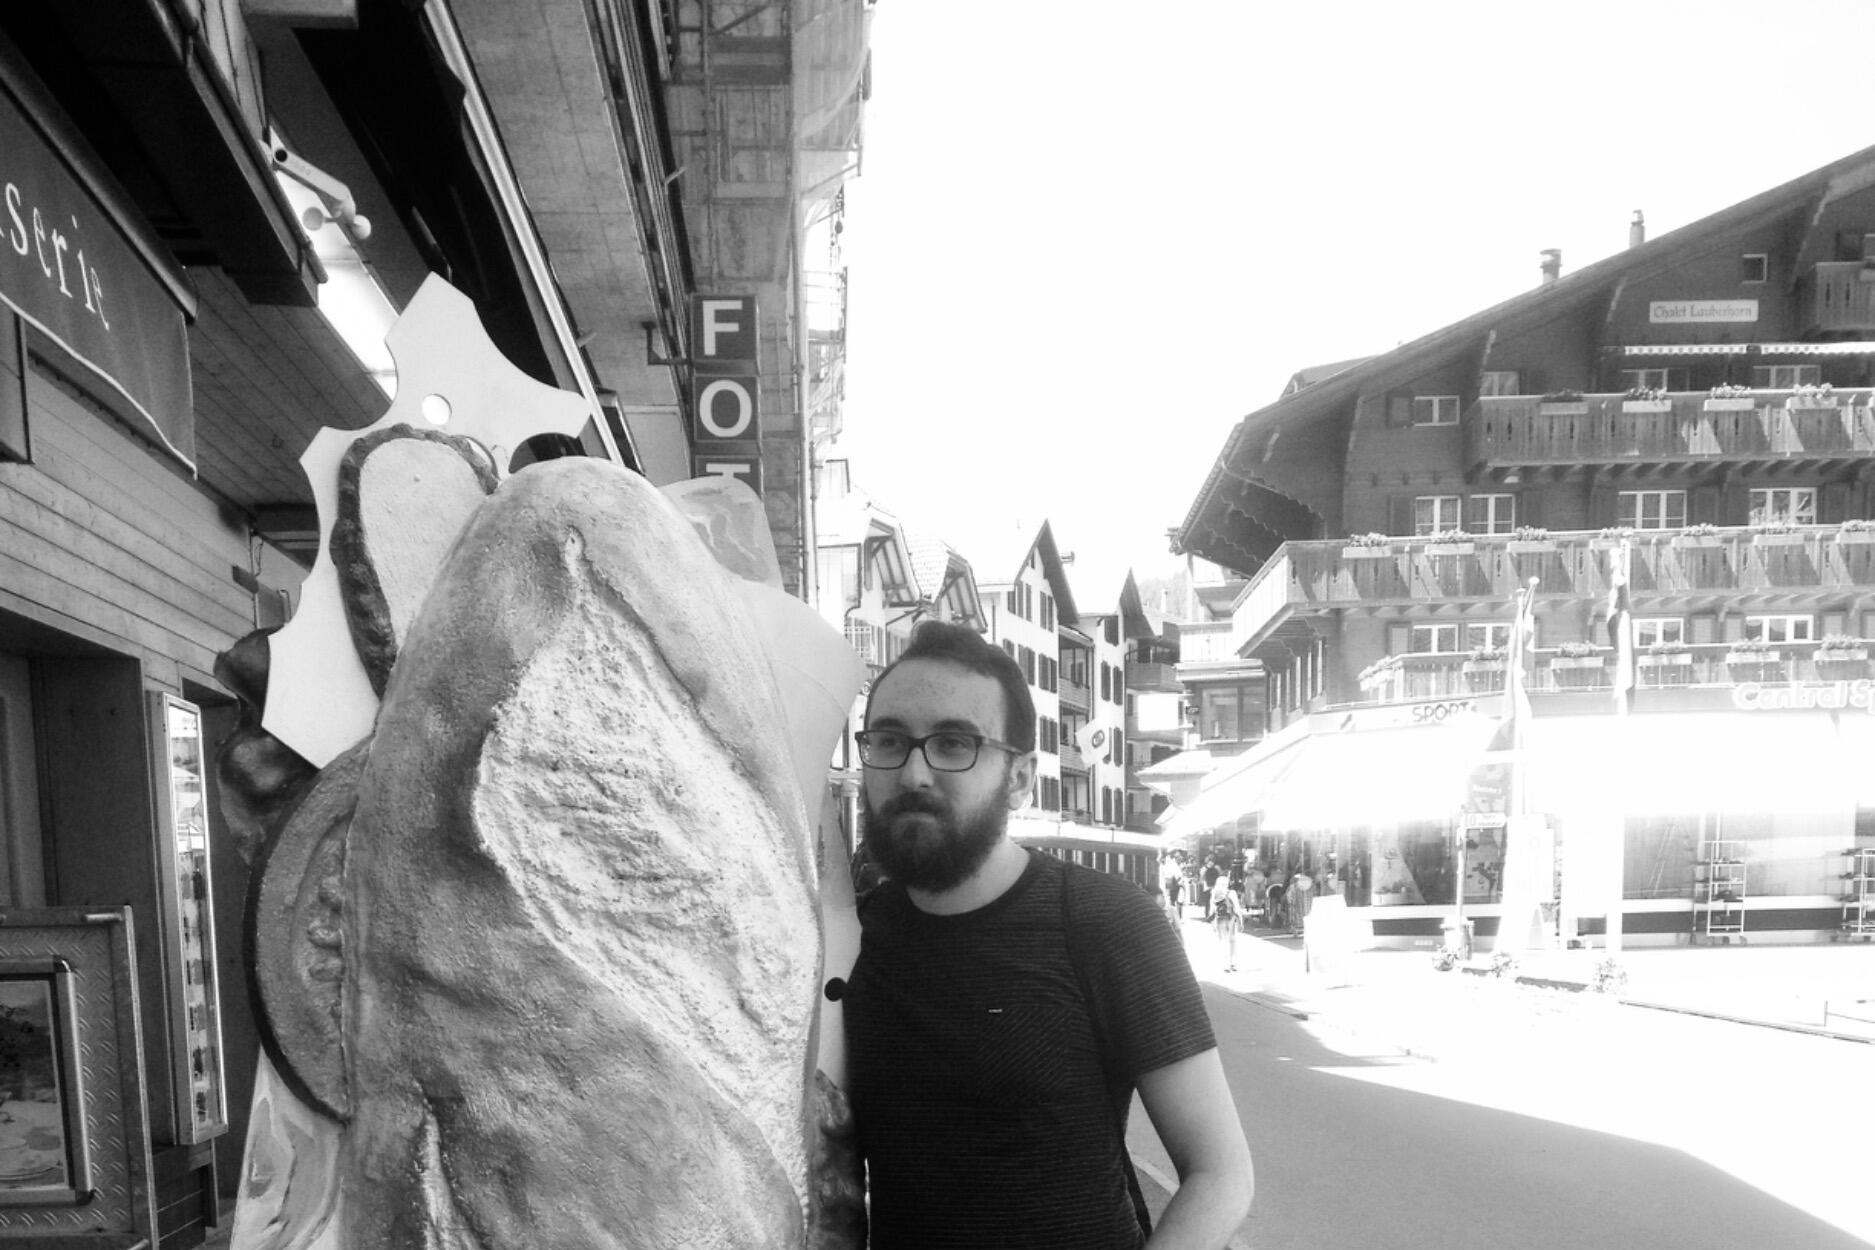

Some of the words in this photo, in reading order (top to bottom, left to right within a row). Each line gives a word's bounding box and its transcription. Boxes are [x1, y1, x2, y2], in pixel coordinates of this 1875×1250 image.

[0, 182, 110, 331] serie
[699, 300, 753, 477] FO
[1733, 681, 1848, 711] Central
